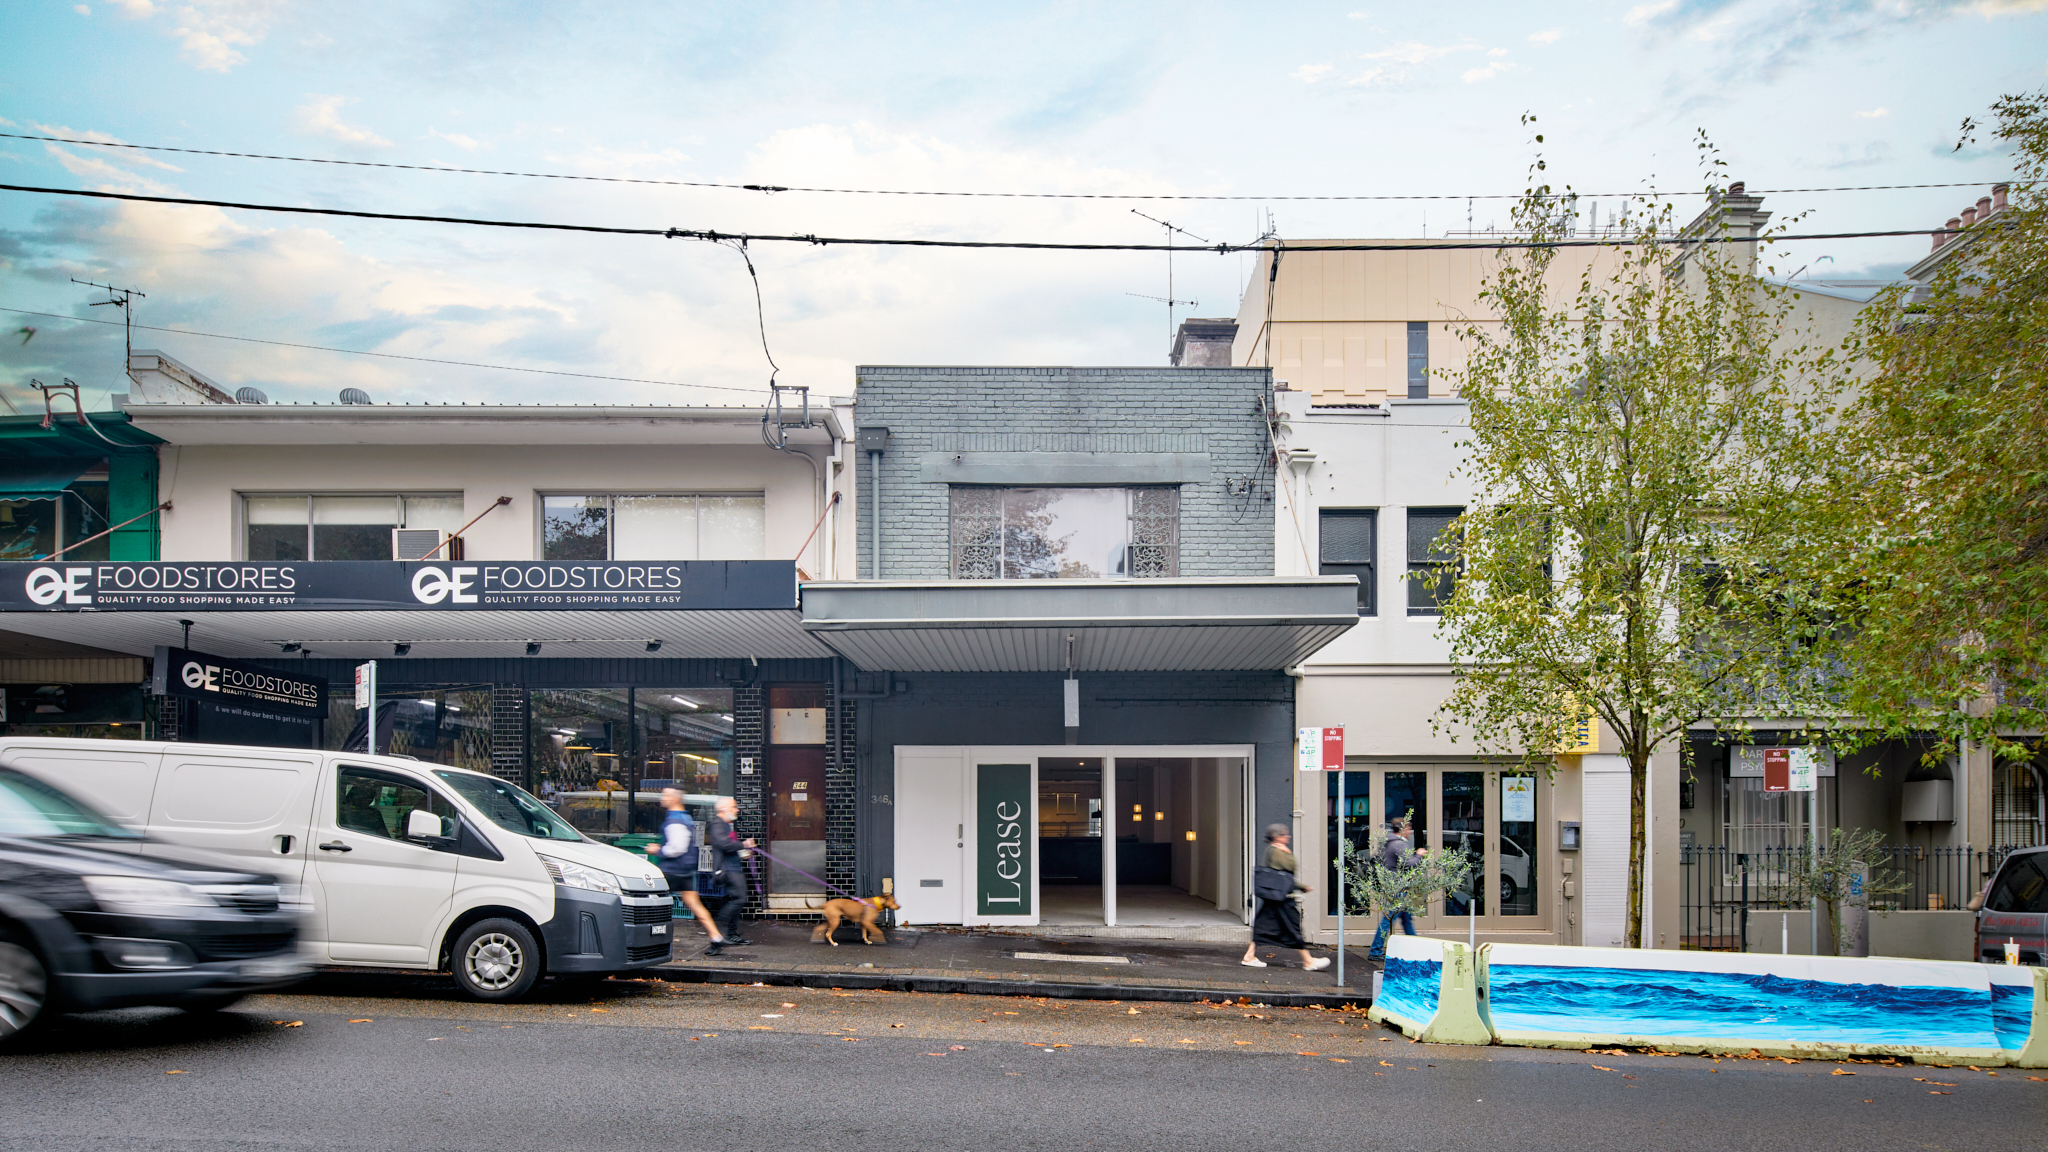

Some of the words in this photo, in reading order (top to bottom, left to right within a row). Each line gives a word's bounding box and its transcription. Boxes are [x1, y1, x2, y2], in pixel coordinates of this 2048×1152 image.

[98, 566, 296, 589] FOODSTORES
[485, 566, 681, 589] FOODSTORES
[98, 596, 142, 605] QUALITY
[147, 596, 174, 605] FOOD
[180, 596, 232, 605] SHOPPING
[236, 596, 264, 605] MADE
[269, 596, 296, 605] EASY
[485, 596, 529, 604] QUALITY
[534, 596, 562, 604] FOOD
[566, 596, 618, 604] SHOPPING
[622, 596, 651, 604] MADE
[656, 596, 681, 604] EASY
[223, 668, 318, 698] FOODSTORES
[222, 688, 246, 696] QUALITY
[264, 695, 289, 704] SHOPPING
[231, 707, 241, 715] will
[243, 708, 250, 716] do
[262, 711, 274, 720] best
[282, 715, 291, 724] get
[987, 800, 1022, 907] Lease
